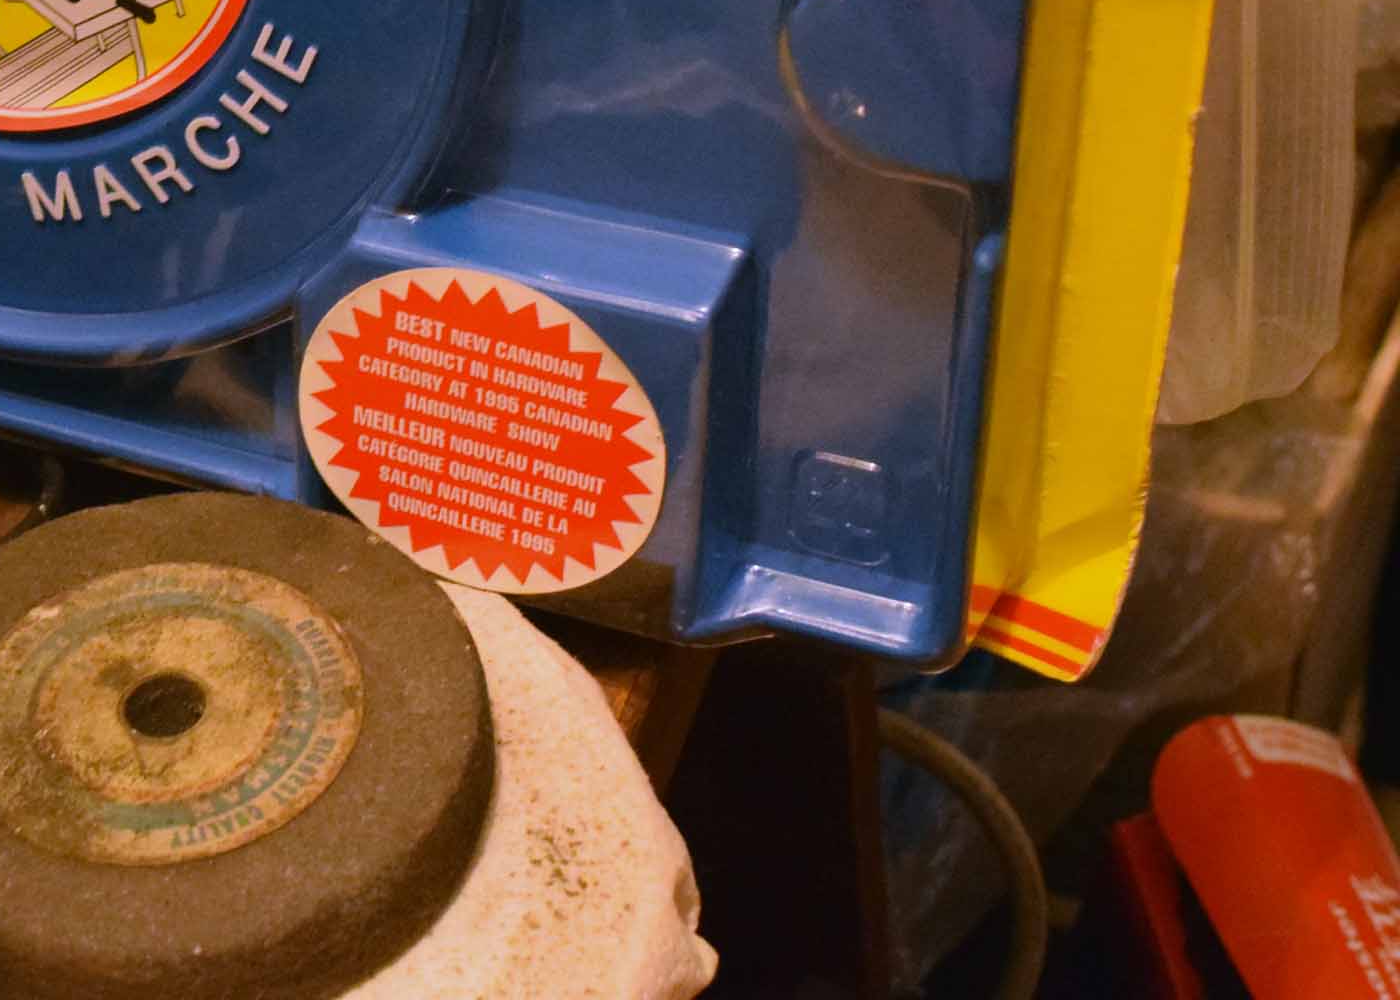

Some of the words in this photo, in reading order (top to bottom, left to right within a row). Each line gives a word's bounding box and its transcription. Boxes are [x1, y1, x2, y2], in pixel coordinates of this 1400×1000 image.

[21, 21, 320, 222] MARCHE
[386, 336, 466, 373] PRODUCT
[469, 359, 490, 380] IN
[493, 366, 588, 409] HARDWARE
[395, 311, 445, 341] BEST
[451, 328, 491, 355] NEW
[495, 341, 585, 381] CANADIAN
[358, 354, 444, 392] CATEGORY
[448, 379, 469, 399] AT
[524, 401, 613, 441] CANADIAN
[404, 392, 498, 433] HARDWARE
[507, 422, 561, 452] SHOW
[353, 405, 446, 449] MEILLEUR
[450, 435, 528, 472] NOUVEAU
[532, 459, 606, 495] PRODUIT
[358, 434, 445, 473] CATÉGORIE
[448, 461, 569, 511] QUINCAILLERIE
[572, 497, 597, 519] AU
[378, 465, 434, 495] SALON
[437, 481, 517, 520] NATIONAL
[521, 507, 545, 528] DE
[547, 514, 569, 535] LA
[387, 492, 505, 541] QUINCAILLERIE
[511, 528, 555, 555] 1995
